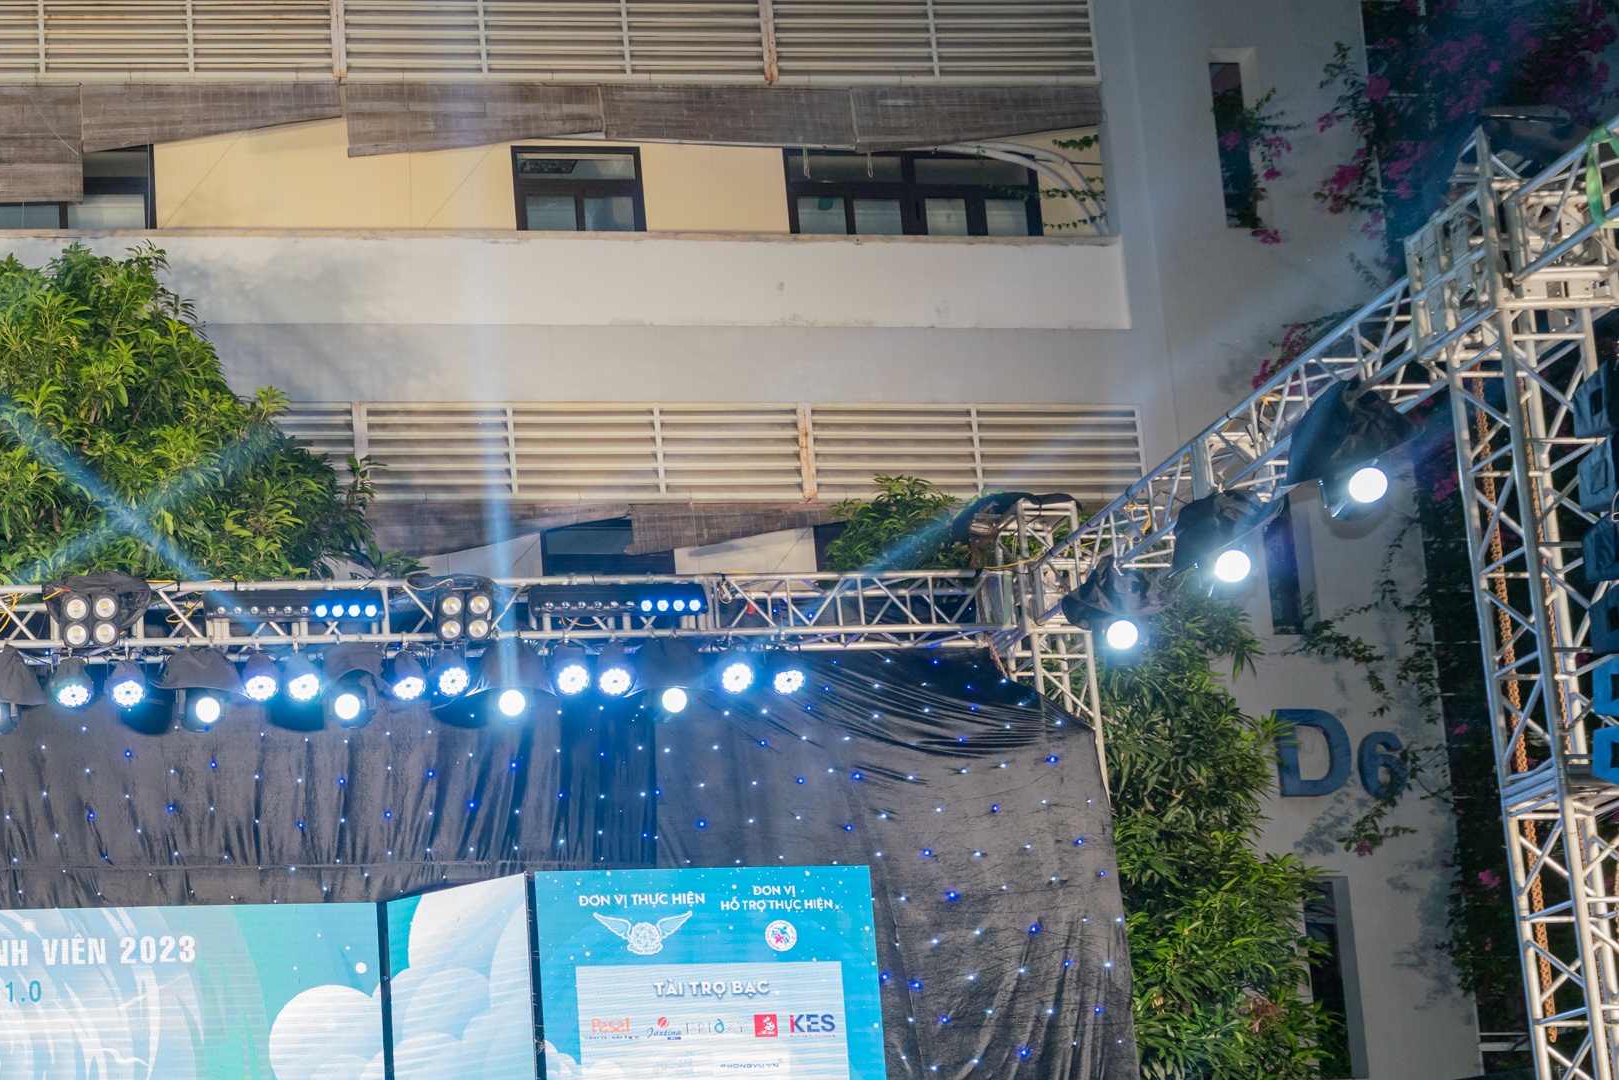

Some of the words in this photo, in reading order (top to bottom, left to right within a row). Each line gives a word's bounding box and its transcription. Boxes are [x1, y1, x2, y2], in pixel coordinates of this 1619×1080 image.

[1272, 709, 1411, 798] D6
[579, 894, 610, 906] ĐƠN
[42, 933, 106, 965] VIÊN
[119, 935, 196, 964] 2023
[653, 978, 684, 996] TÀI
[689, 981, 726, 998] TRỢ
[731, 980, 769, 998] BẠC
